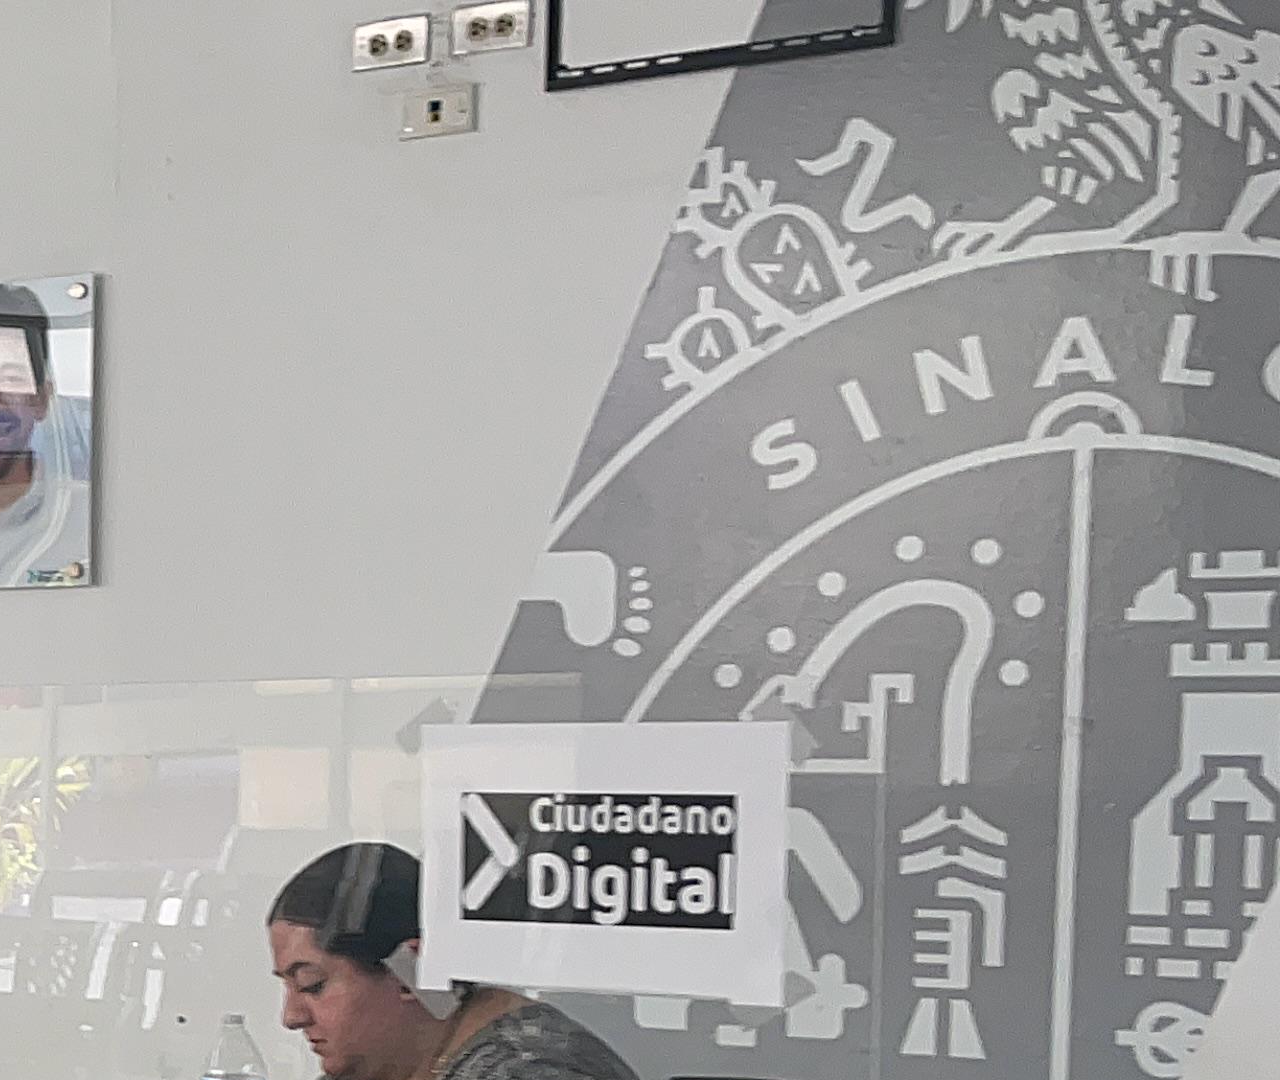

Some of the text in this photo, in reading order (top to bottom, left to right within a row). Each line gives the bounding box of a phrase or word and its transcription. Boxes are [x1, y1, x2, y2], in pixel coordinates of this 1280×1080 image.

[750, 314, 1280, 490] SINAL
[530, 793, 736, 835] Ciudadano
[527, 846, 735, 925] Digital
